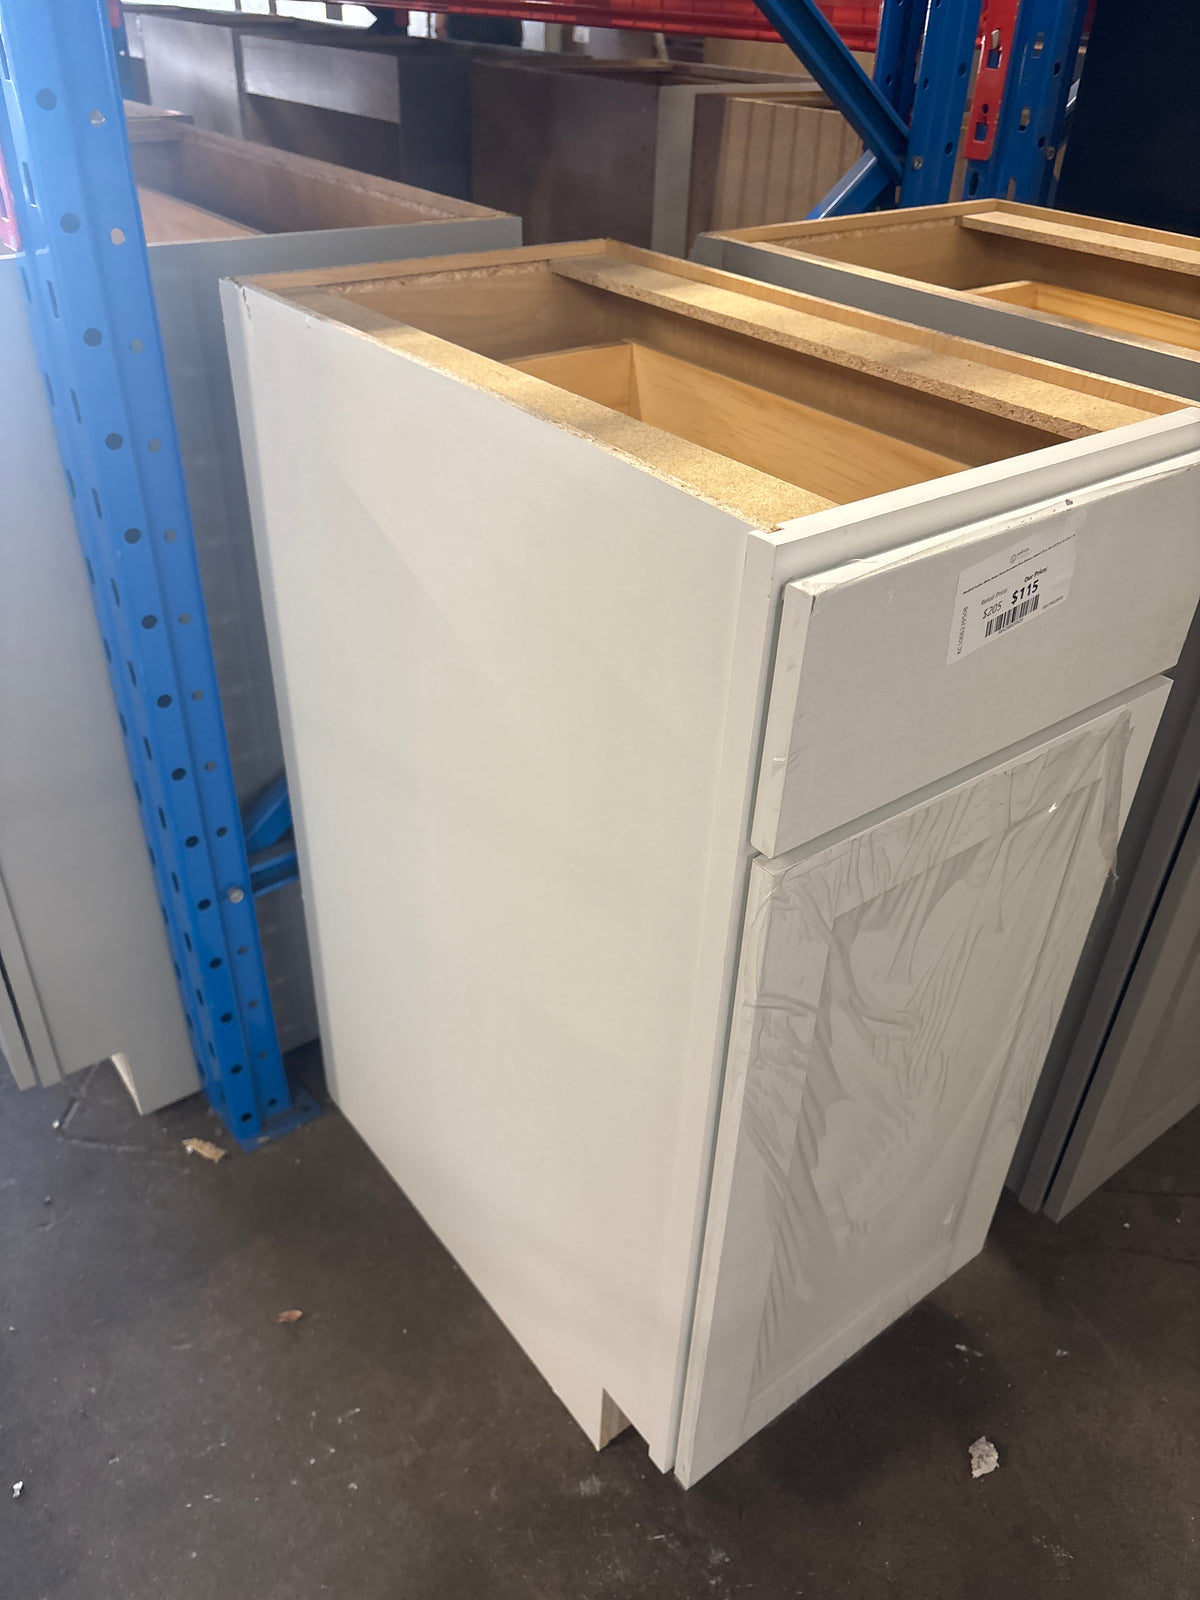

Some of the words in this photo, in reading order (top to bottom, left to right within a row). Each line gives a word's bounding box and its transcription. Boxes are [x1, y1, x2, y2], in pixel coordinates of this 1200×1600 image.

[1024, 574, 1034, 583] Our
[1034, 567, 1049, 578] Price:
[1011, 579, 1039, 605] $115
[982, 601, 1003, 620] $205
